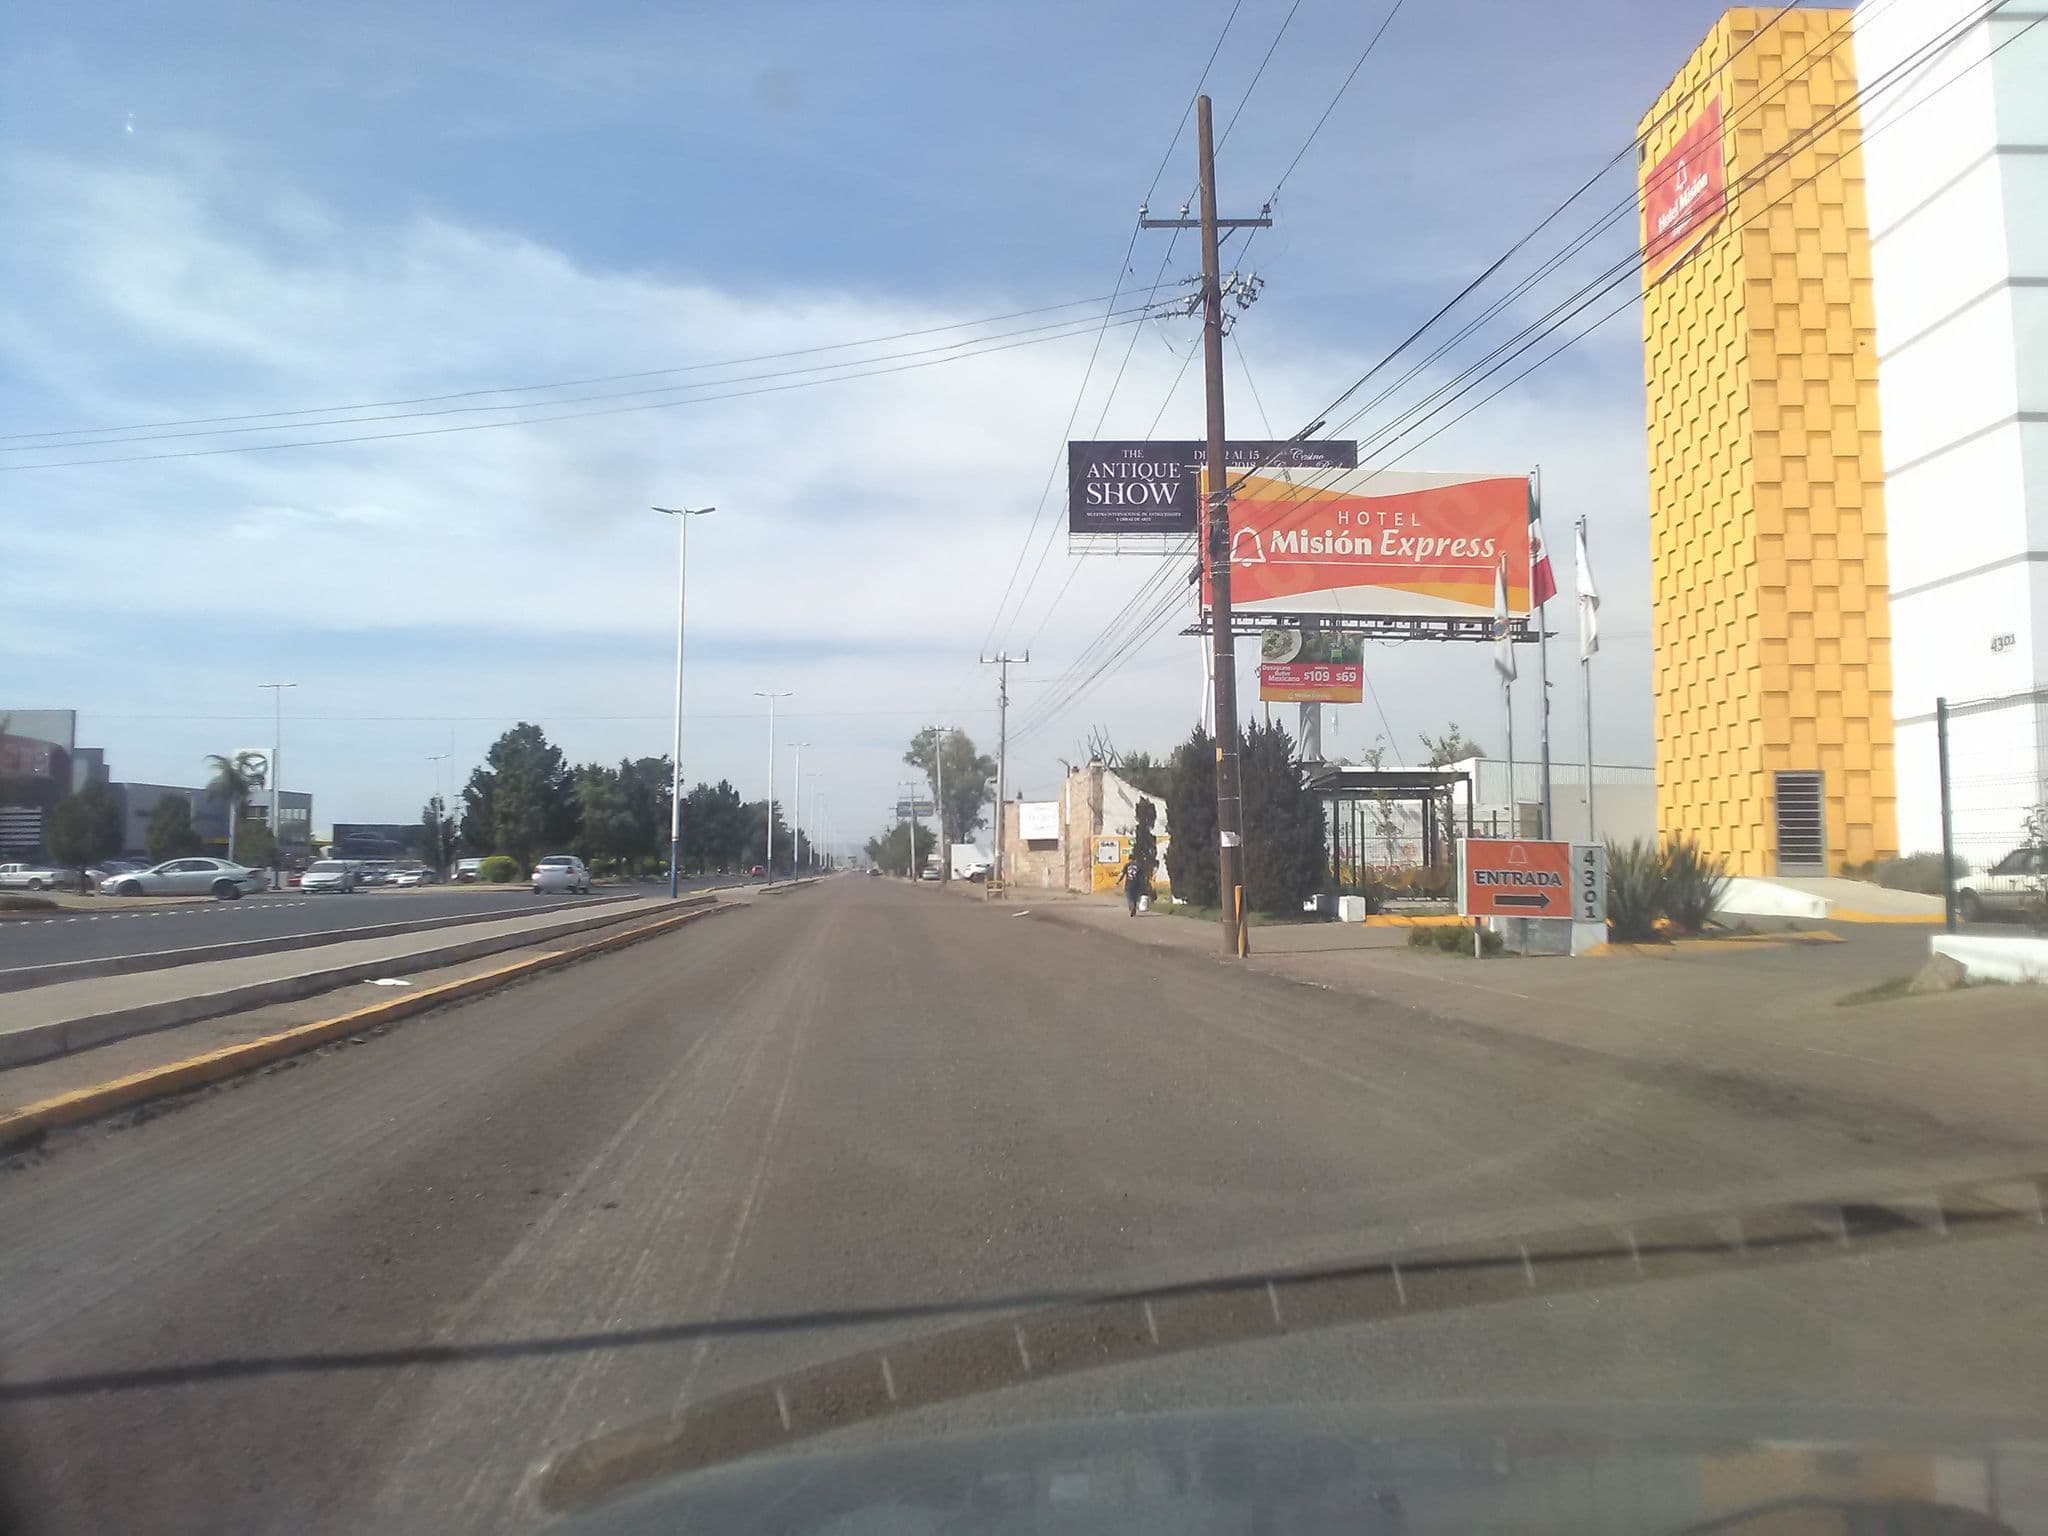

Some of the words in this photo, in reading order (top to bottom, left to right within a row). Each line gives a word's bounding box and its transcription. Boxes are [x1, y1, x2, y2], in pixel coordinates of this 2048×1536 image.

[1122, 449, 1144, 458] THE
[1249, 450, 1260, 460] 15
[1087, 462, 1182, 482] ANTIQUE
[1086, 482, 1181, 505] SHOW
[1337, 510, 1421, 527] HOTEL
[1269, 528, 1373, 556] Misión
[1379, 529, 1496, 563] Express
[1990, 633, 2016, 652] 4301
[1303, 671, 1330, 682] $109
[1336, 671, 1357, 682] $69
[1474, 869, 1563, 886] ENTRADA
[1583, 850, 1597, 919] 4301
